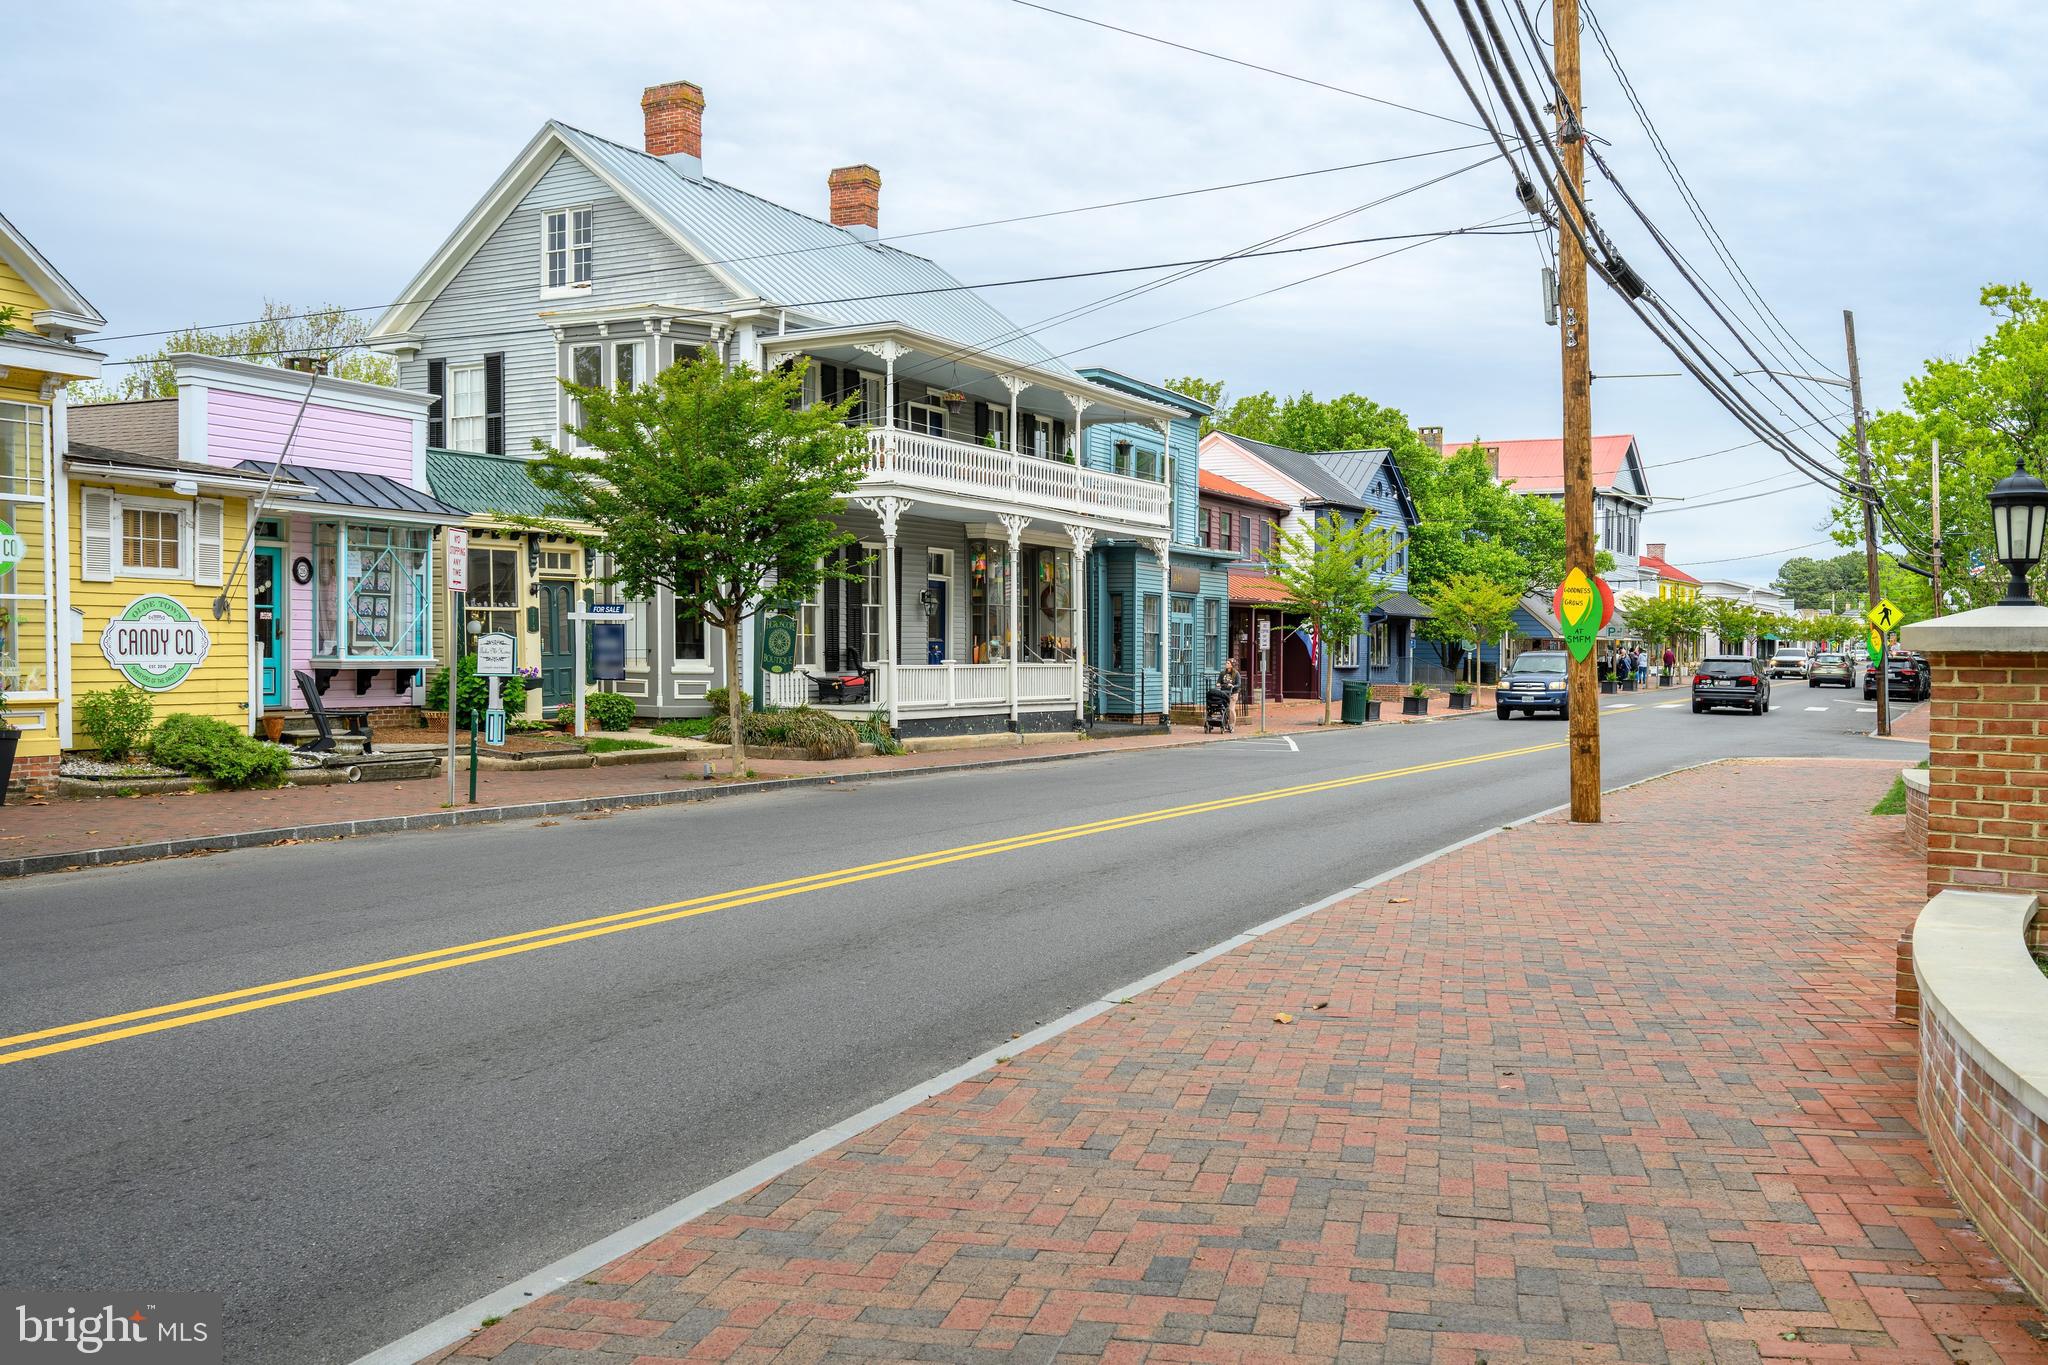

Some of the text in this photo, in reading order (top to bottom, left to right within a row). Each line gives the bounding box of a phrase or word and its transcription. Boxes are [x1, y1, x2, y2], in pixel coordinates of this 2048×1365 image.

[453, 558, 462, 567] ANY
[131, 600, 184, 619] OLDE TOWN
[118, 628, 197, 656] CANDY CO.
[1566, 635, 1591, 644] SMFM
[763, 653, 793, 665] BOUTIQUE
